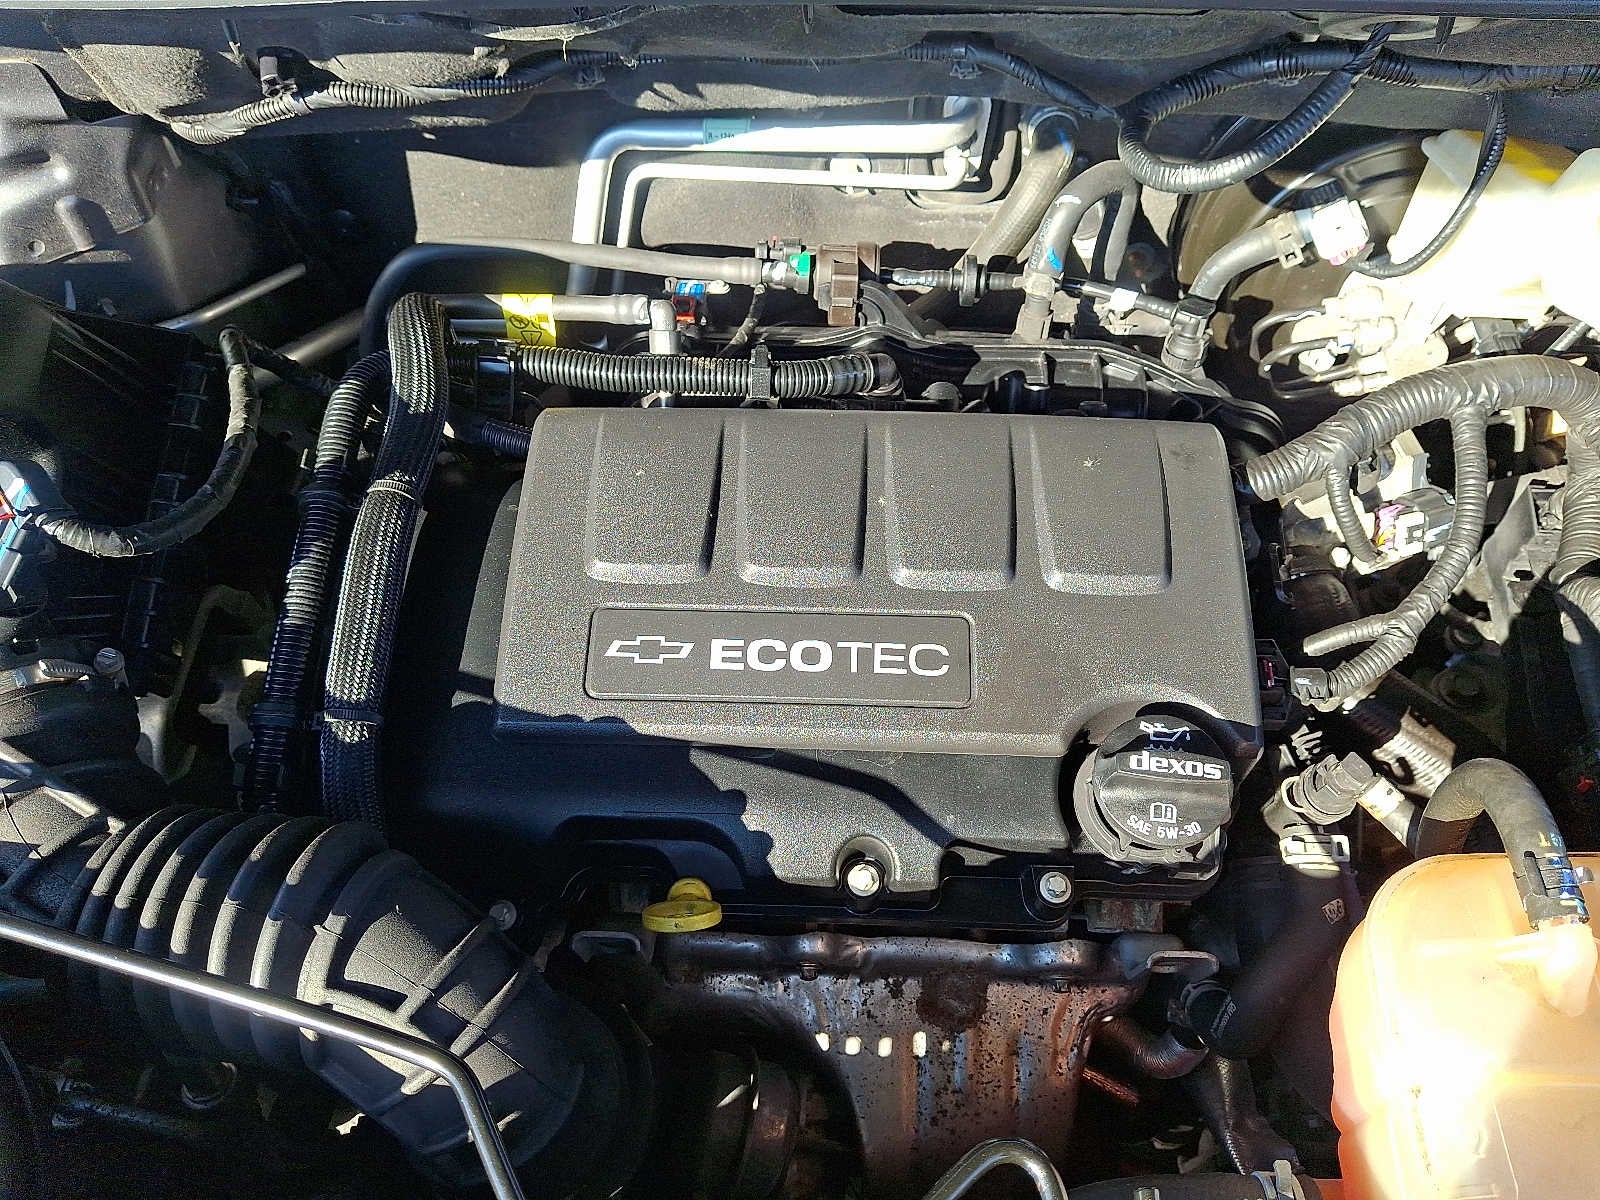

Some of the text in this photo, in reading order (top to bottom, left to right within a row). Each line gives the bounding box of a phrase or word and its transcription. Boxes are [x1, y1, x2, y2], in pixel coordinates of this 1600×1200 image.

[709, 638, 950, 677] ECOTEC
[1129, 750, 1224, 780] dexos
[1127, 814, 1202, 840] SAE 5W-30
